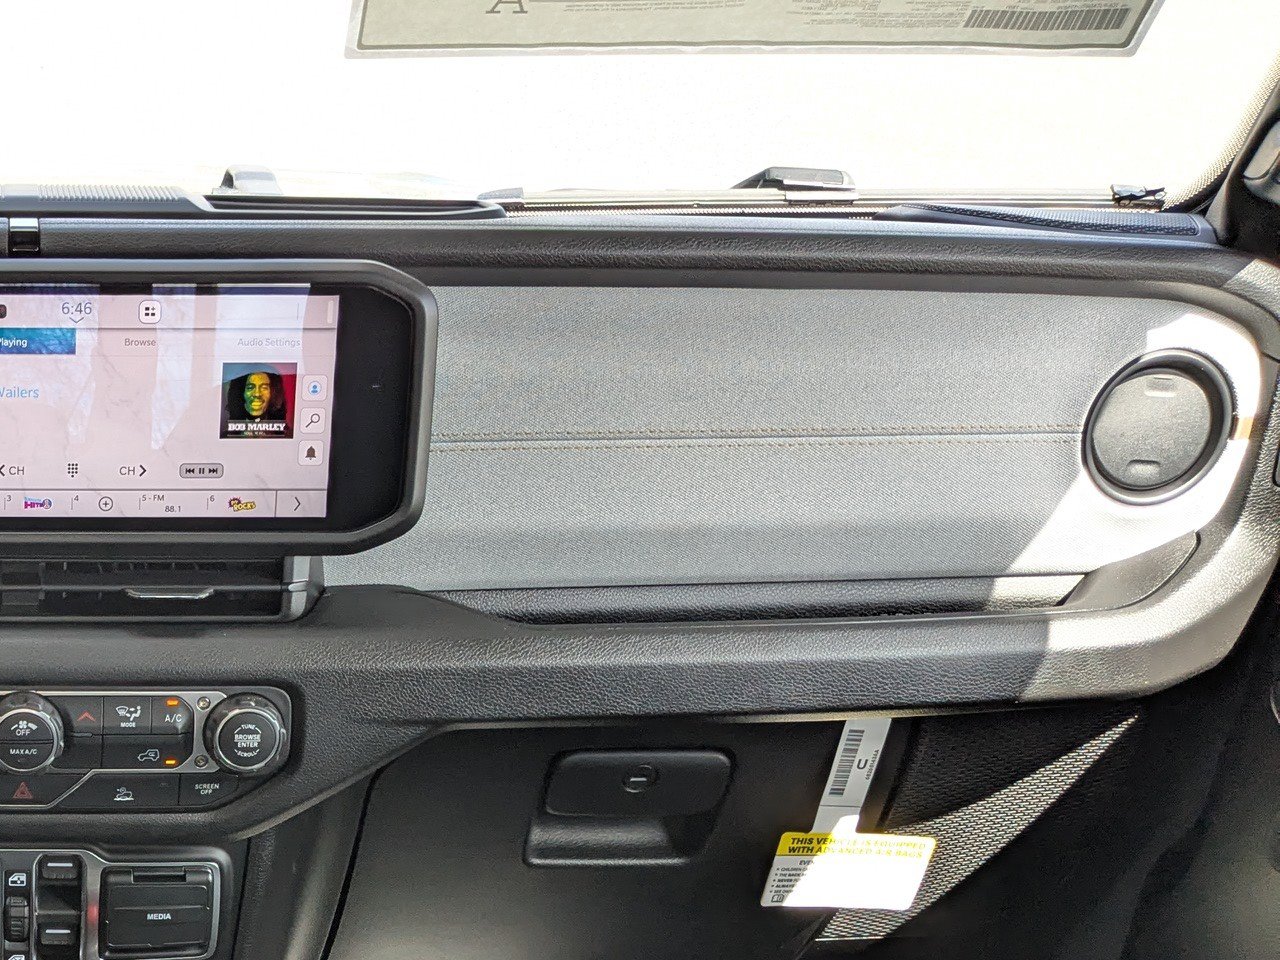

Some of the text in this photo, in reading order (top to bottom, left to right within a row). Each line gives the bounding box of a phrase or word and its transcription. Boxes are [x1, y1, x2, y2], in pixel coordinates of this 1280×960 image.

[61, 301, 92, 315] 6:46
[124, 338, 156, 347] Browse
[237, 338, 301, 349] Audio Settings
[228, 423, 286, 431] BOB MARLEY
[9, 466, 25, 475] CH
[119, 466, 136, 475] CH
[165, 505, 182, 513] 88.1
[164, 714, 182, 723] A/C
[25, 748, 38, 756] A/C
[857, 759, 869, 770] U
[791, 837, 815, 845] THIS
[788, 846, 815, 854] WITH
